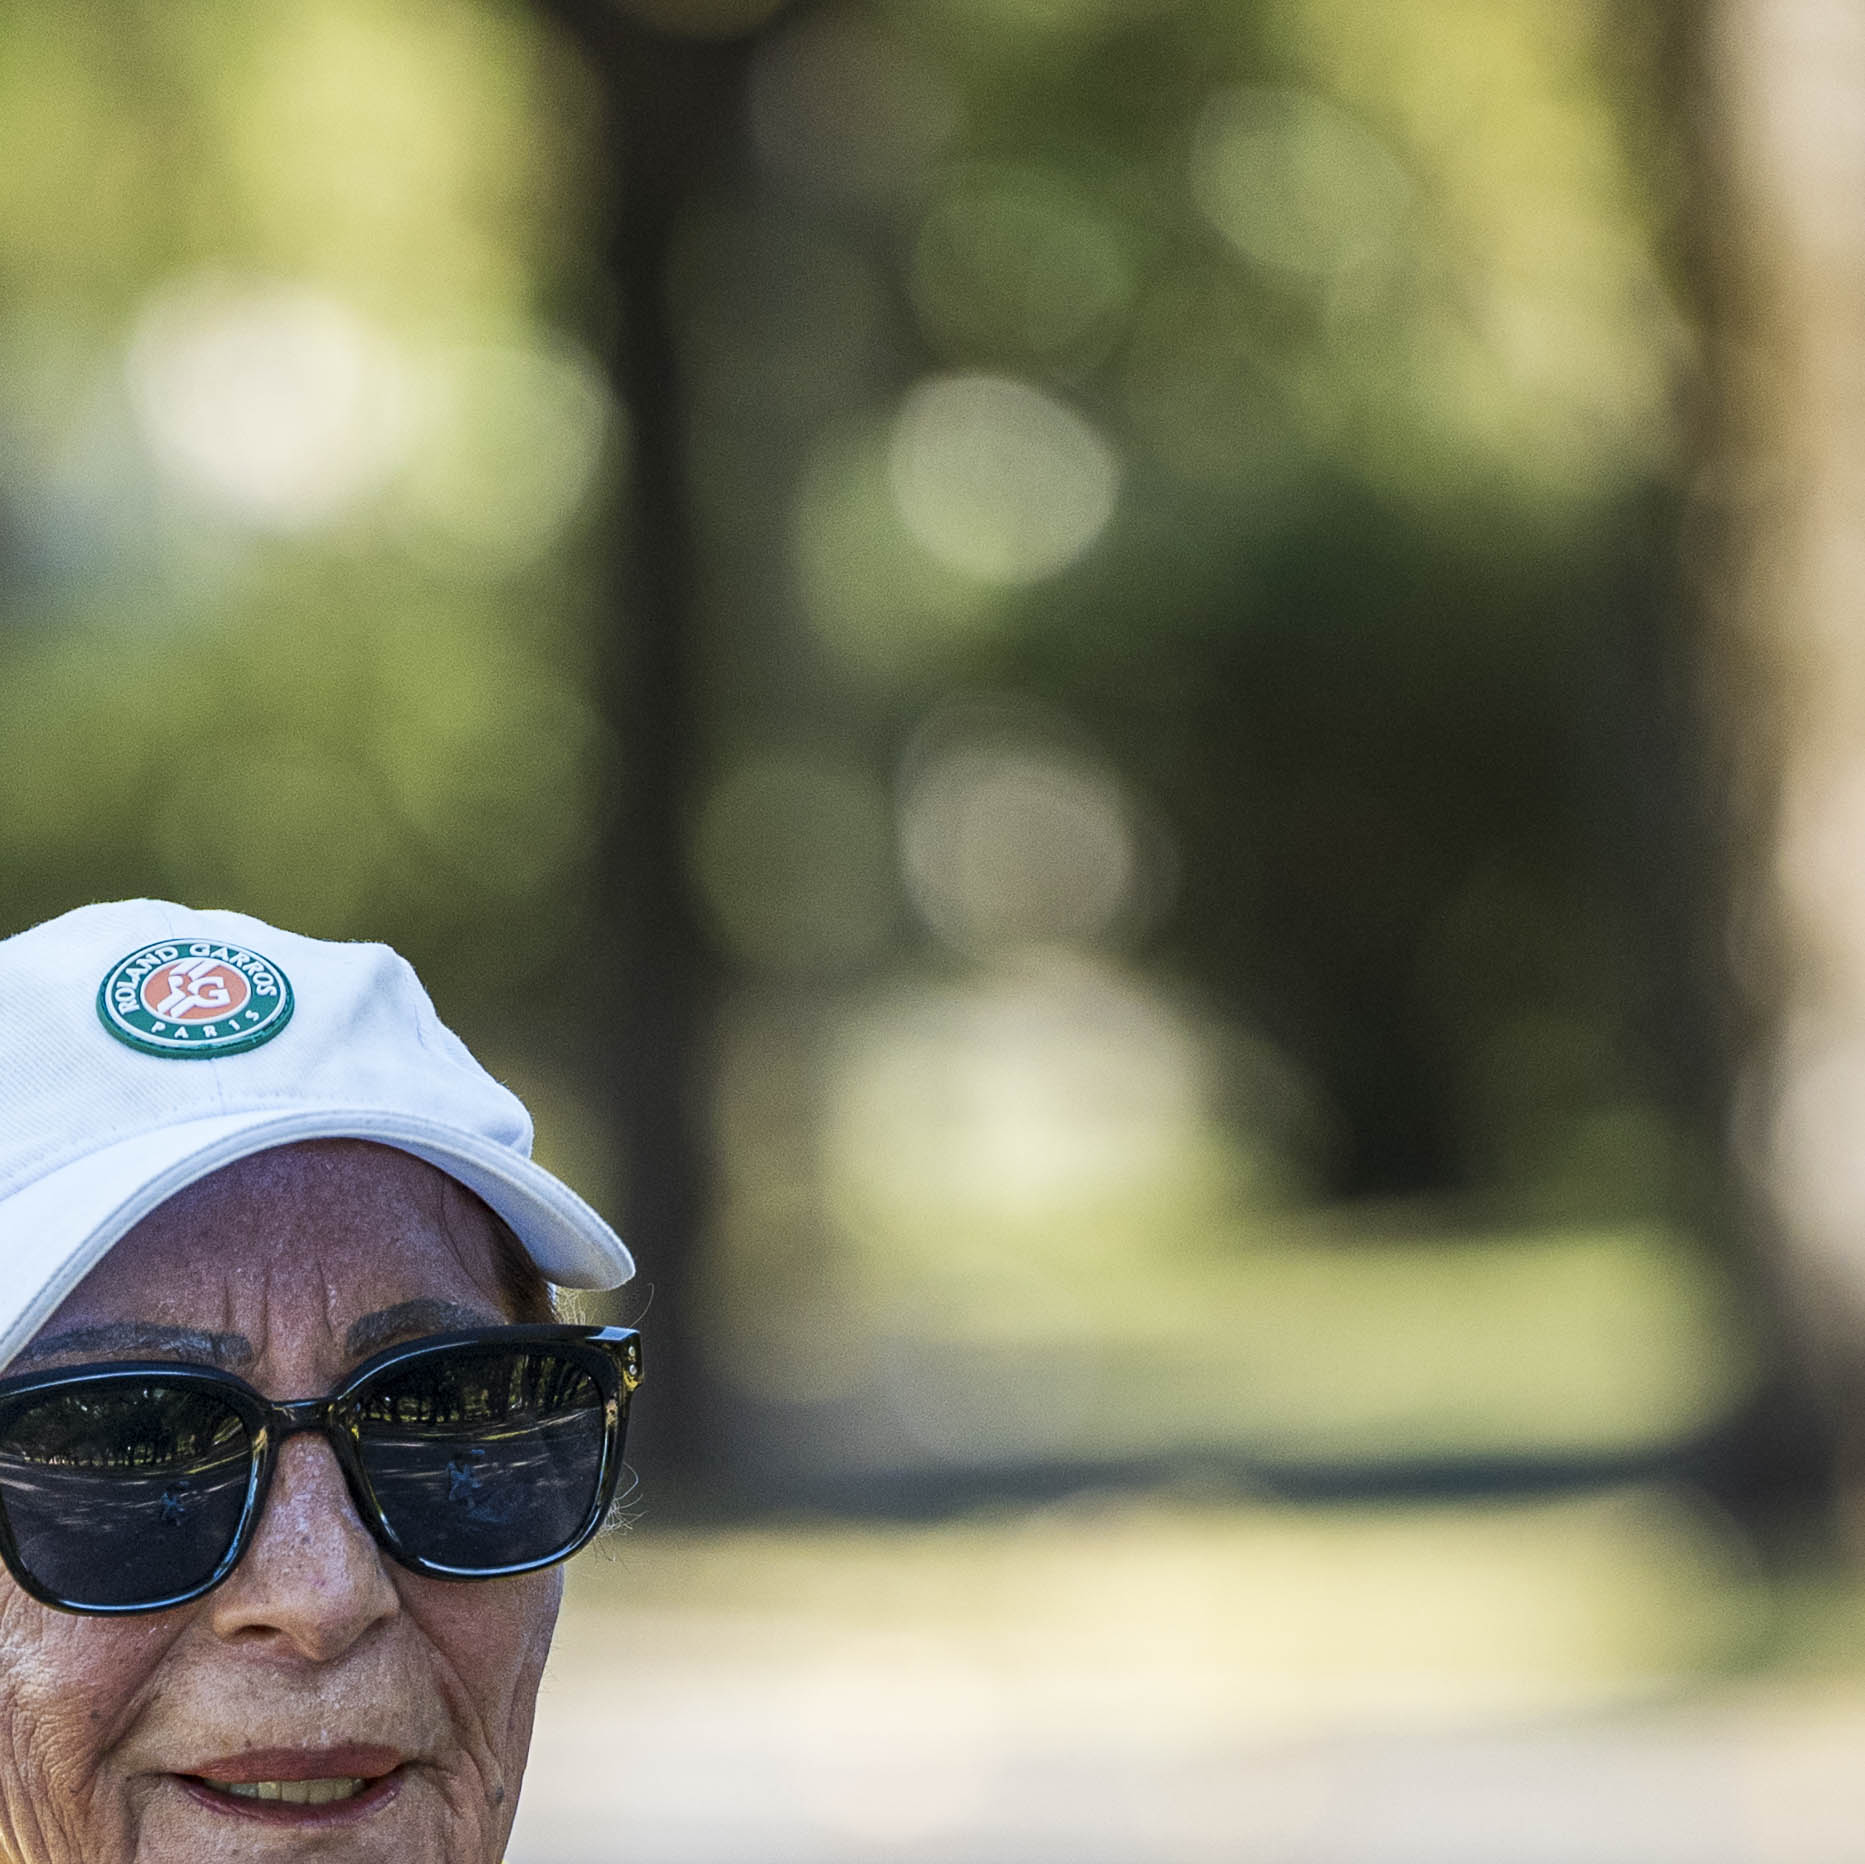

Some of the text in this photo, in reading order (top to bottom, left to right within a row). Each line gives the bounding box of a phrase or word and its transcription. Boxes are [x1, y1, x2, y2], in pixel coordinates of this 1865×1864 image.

[115, 943, 277, 1015] ROLAND GARROS
[151, 1009, 260, 1039] PARIS
